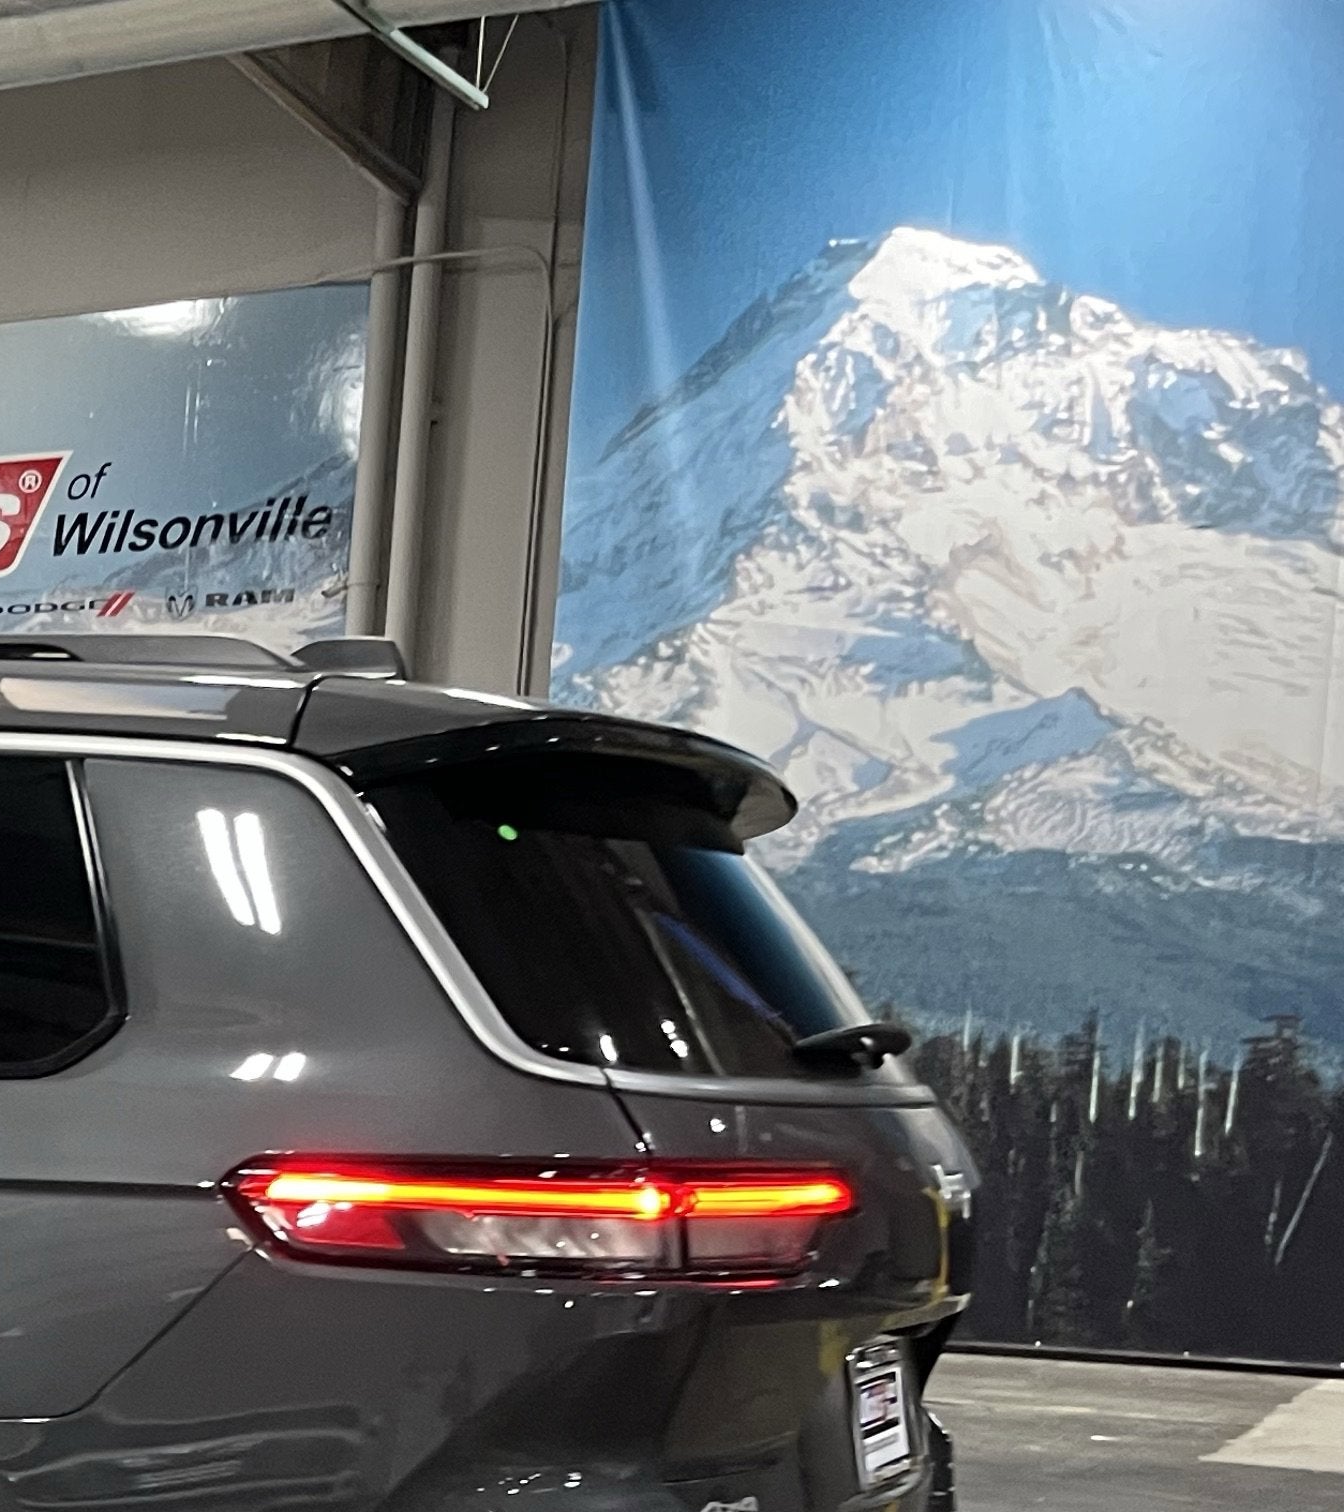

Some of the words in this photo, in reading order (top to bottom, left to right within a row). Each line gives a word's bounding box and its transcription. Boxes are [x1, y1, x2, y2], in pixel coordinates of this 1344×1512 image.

[67, 461, 113, 501] of
[51, 495, 333, 558] Wilsonville
[204, 587, 296, 608] RAM
